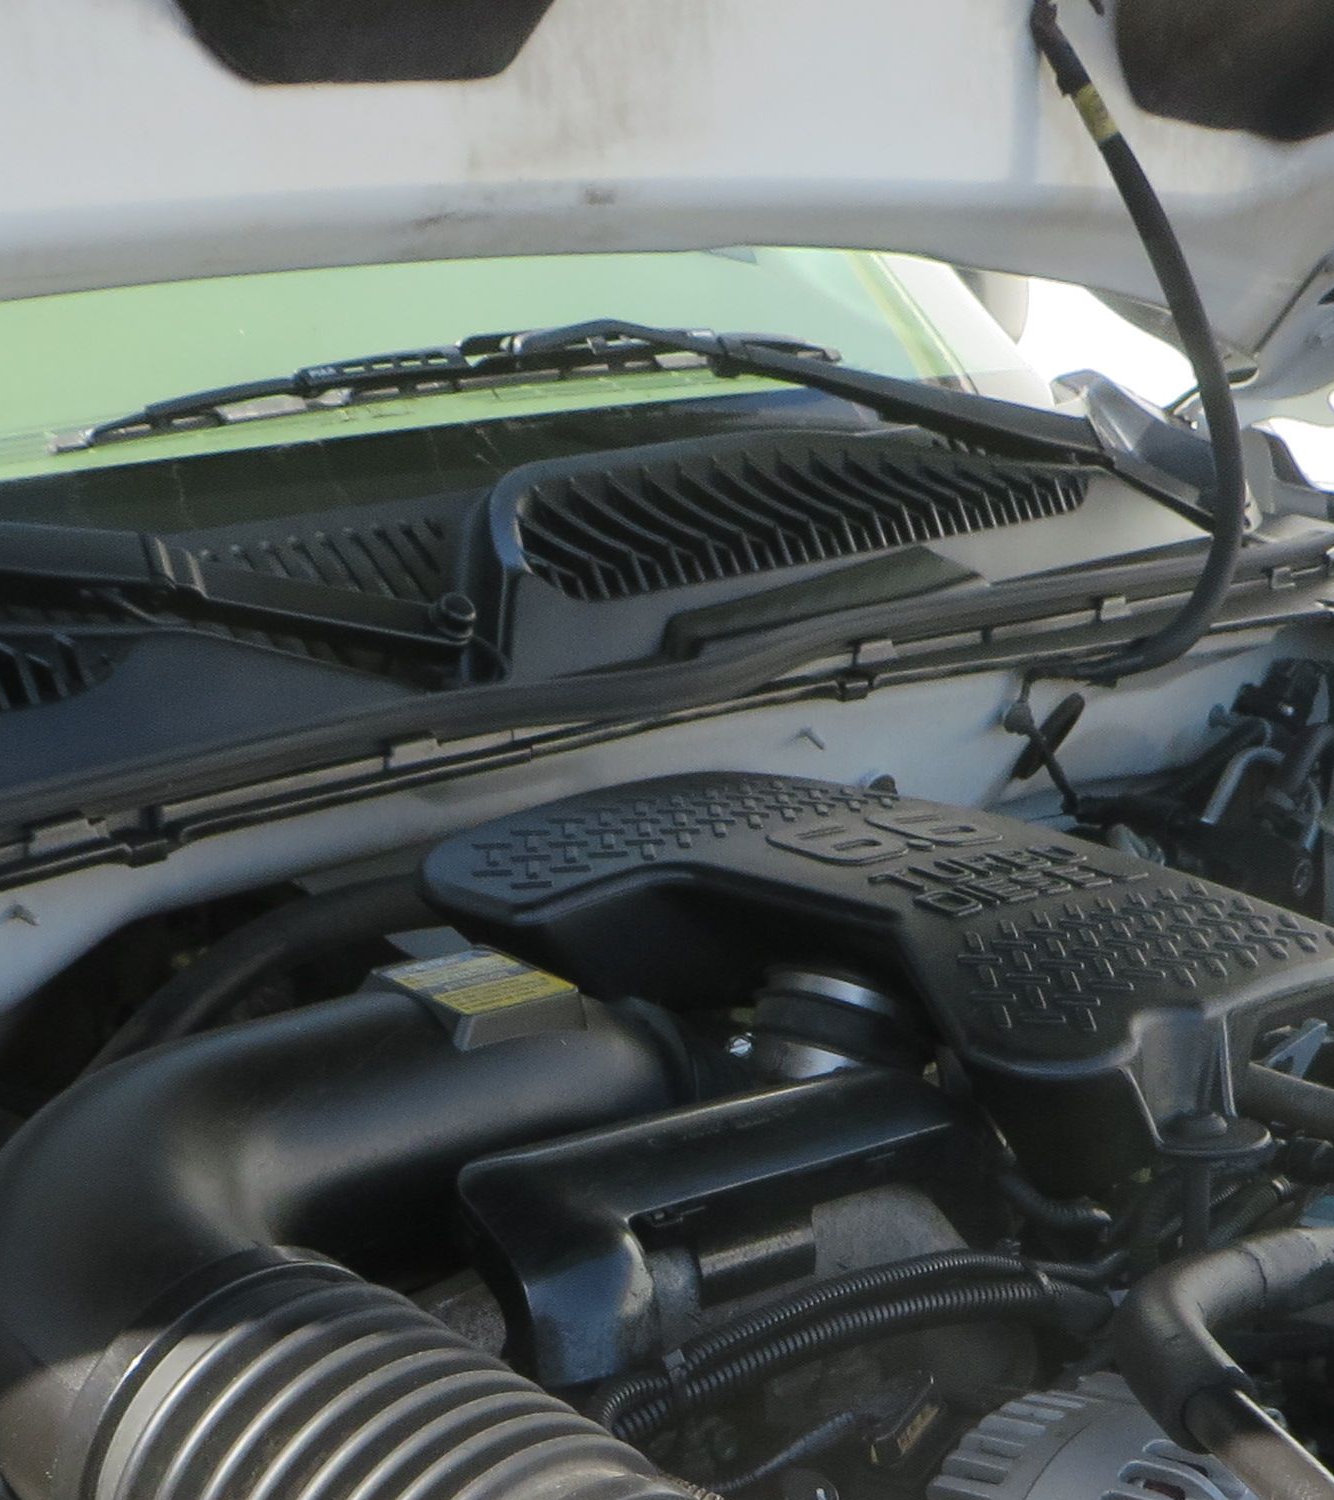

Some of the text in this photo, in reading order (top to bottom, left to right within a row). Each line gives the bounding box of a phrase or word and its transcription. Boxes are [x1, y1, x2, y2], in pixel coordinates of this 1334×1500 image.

[766, 812, 1004, 866] 6.6
[868, 844, 1087, 892] TURBO
[913, 863, 1150, 918] DIESEL
